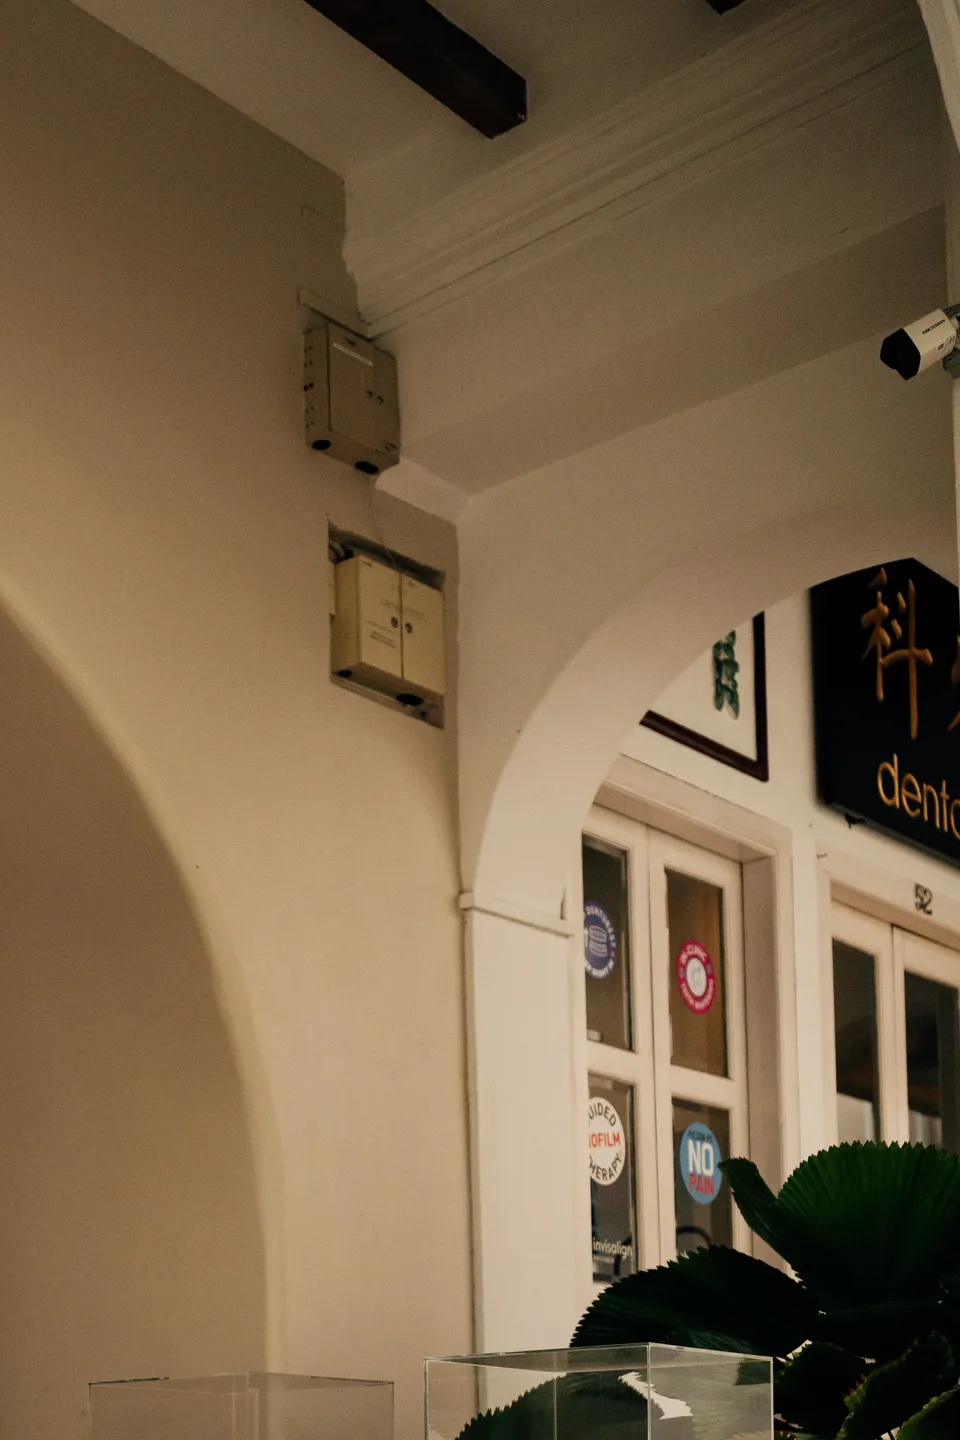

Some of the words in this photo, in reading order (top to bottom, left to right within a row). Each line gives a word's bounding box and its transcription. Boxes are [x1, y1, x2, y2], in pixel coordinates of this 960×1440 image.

[915, 882, 933, 917] 52
[588, 1102, 617, 1127] UIDED
[588, 1131, 621, 1148] IOFILM
[688, 1139, 715, 1177] NO
[688, 1171, 715, 1197] PAIN
[593, 1237, 633, 1260] invisalign
